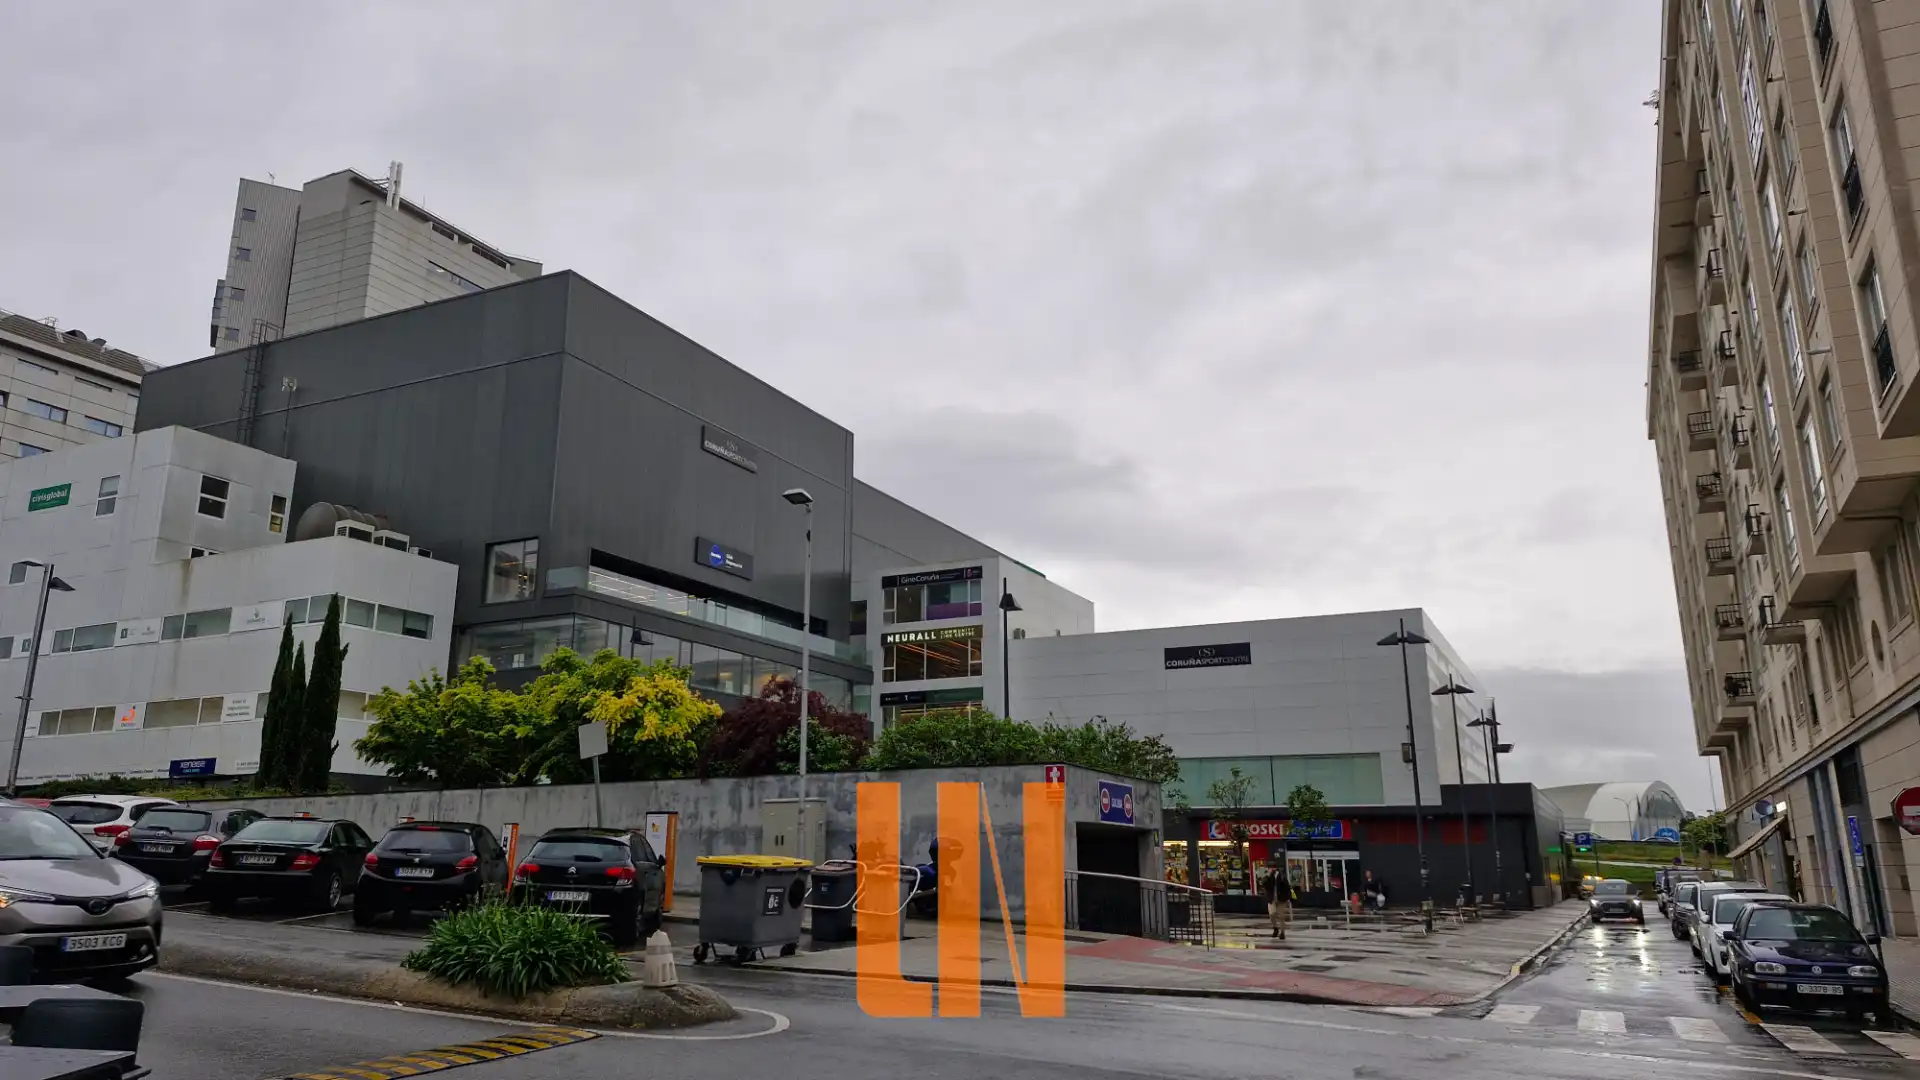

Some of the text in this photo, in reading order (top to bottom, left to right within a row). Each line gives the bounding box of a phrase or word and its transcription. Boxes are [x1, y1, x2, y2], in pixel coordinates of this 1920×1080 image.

[32, 489, 68, 502] civisglobal
[887, 631, 937, 643] NEURALL
[1577, 834, 1586, 844] P
[70, 937, 99, 949] 3503
